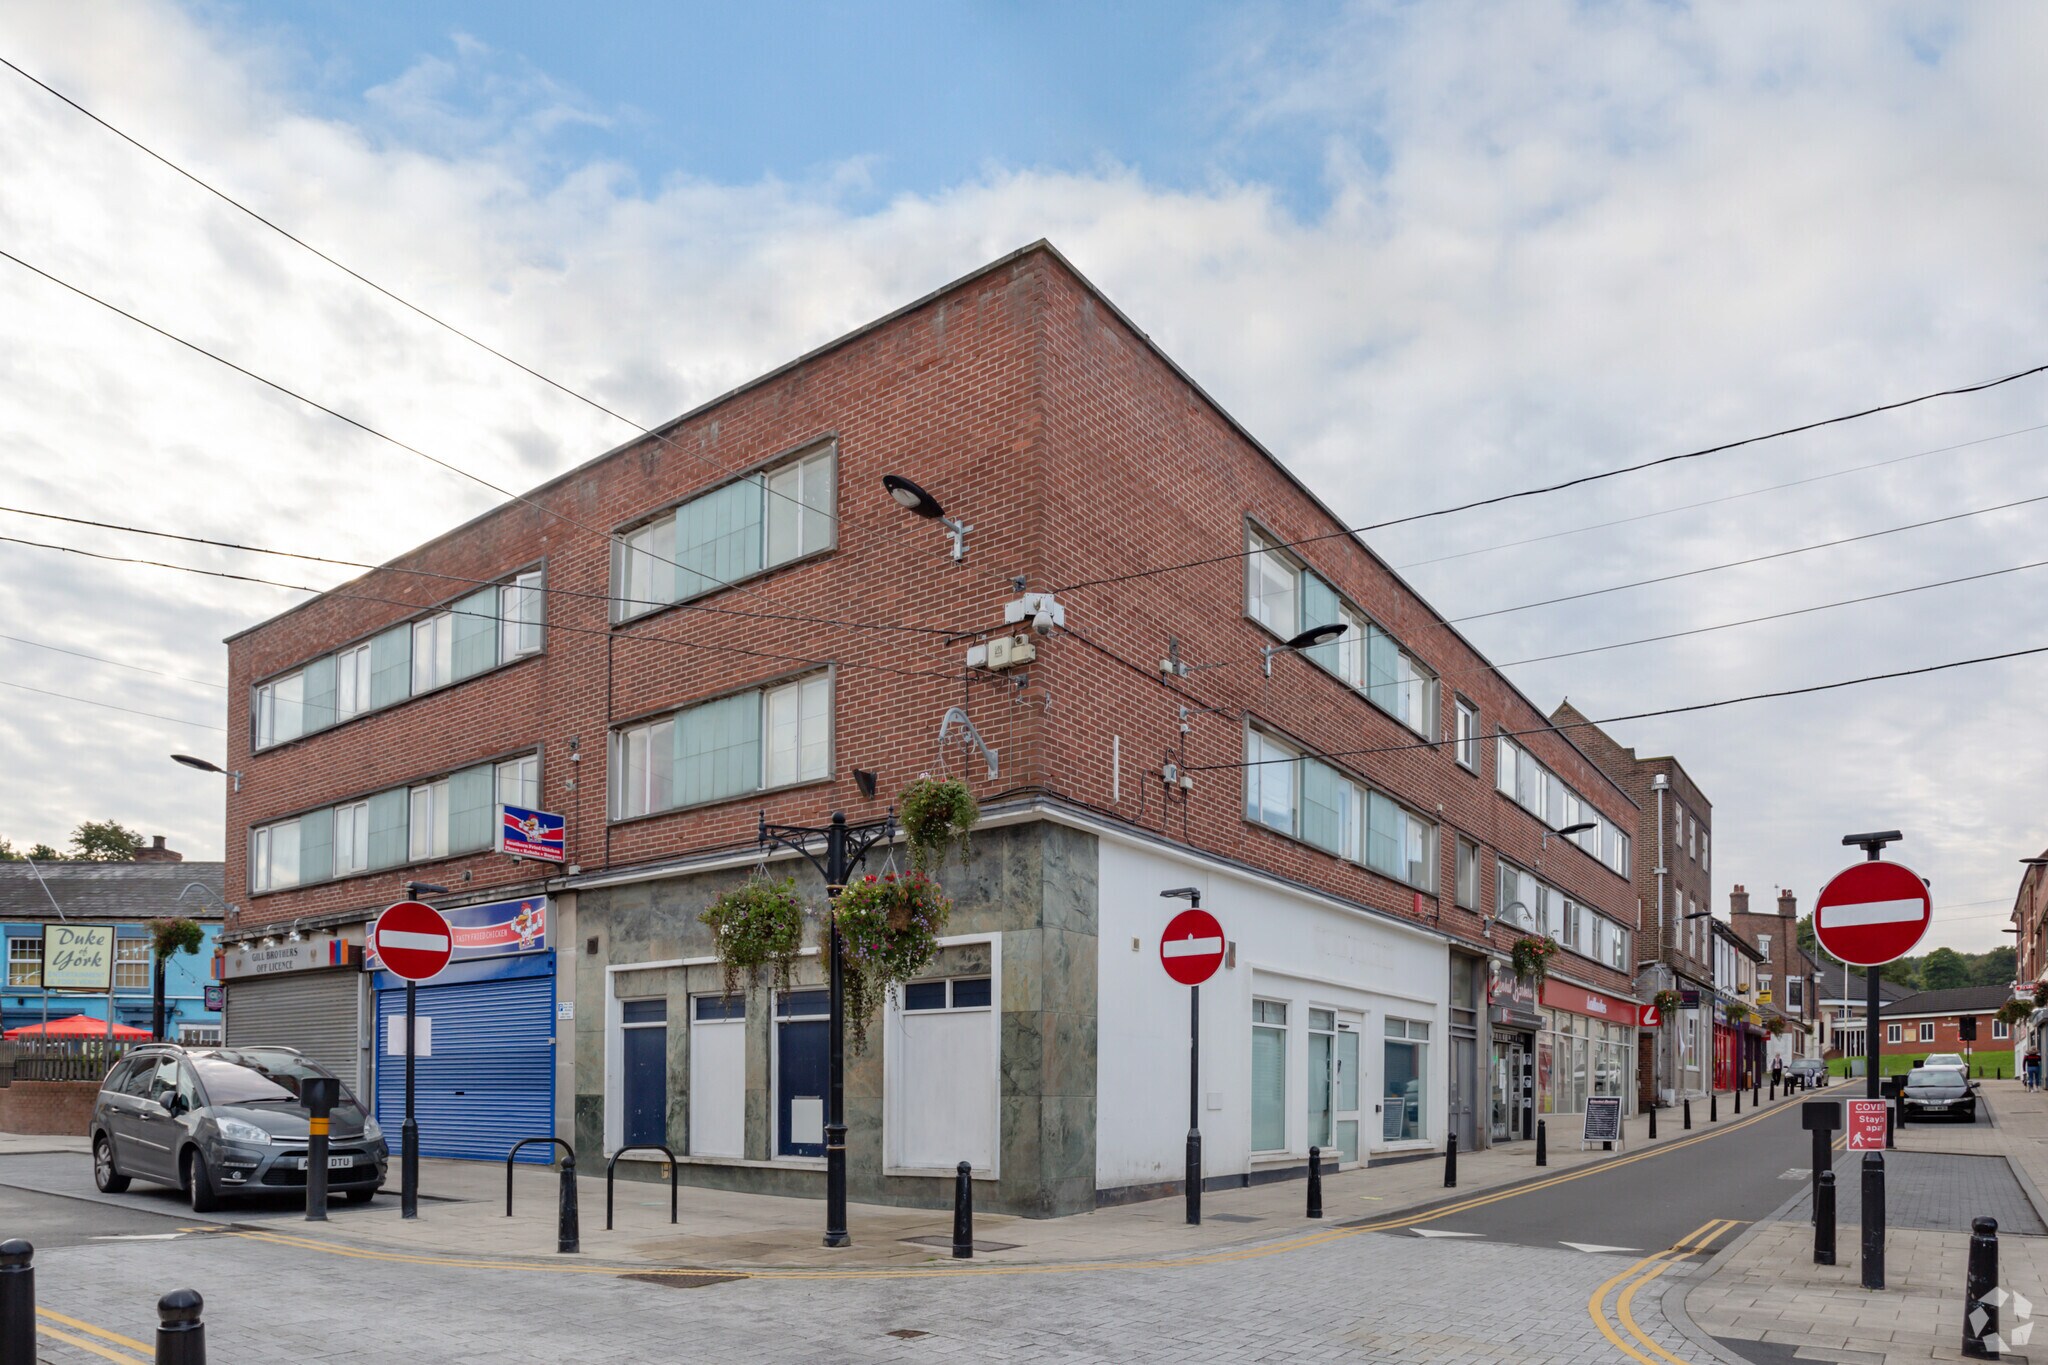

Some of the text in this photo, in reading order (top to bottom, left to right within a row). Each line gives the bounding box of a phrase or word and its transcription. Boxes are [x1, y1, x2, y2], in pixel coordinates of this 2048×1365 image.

[542, 846, 560, 854] Chicken
[56, 928, 105, 945] Duke
[79, 946, 88, 956] of
[252, 948, 298, 961] GILL BROTHERS
[52, 950, 102, 971] York
[257, 960, 294, 973] OFF LICENCE
[331, 1158, 350, 1167] DTU
